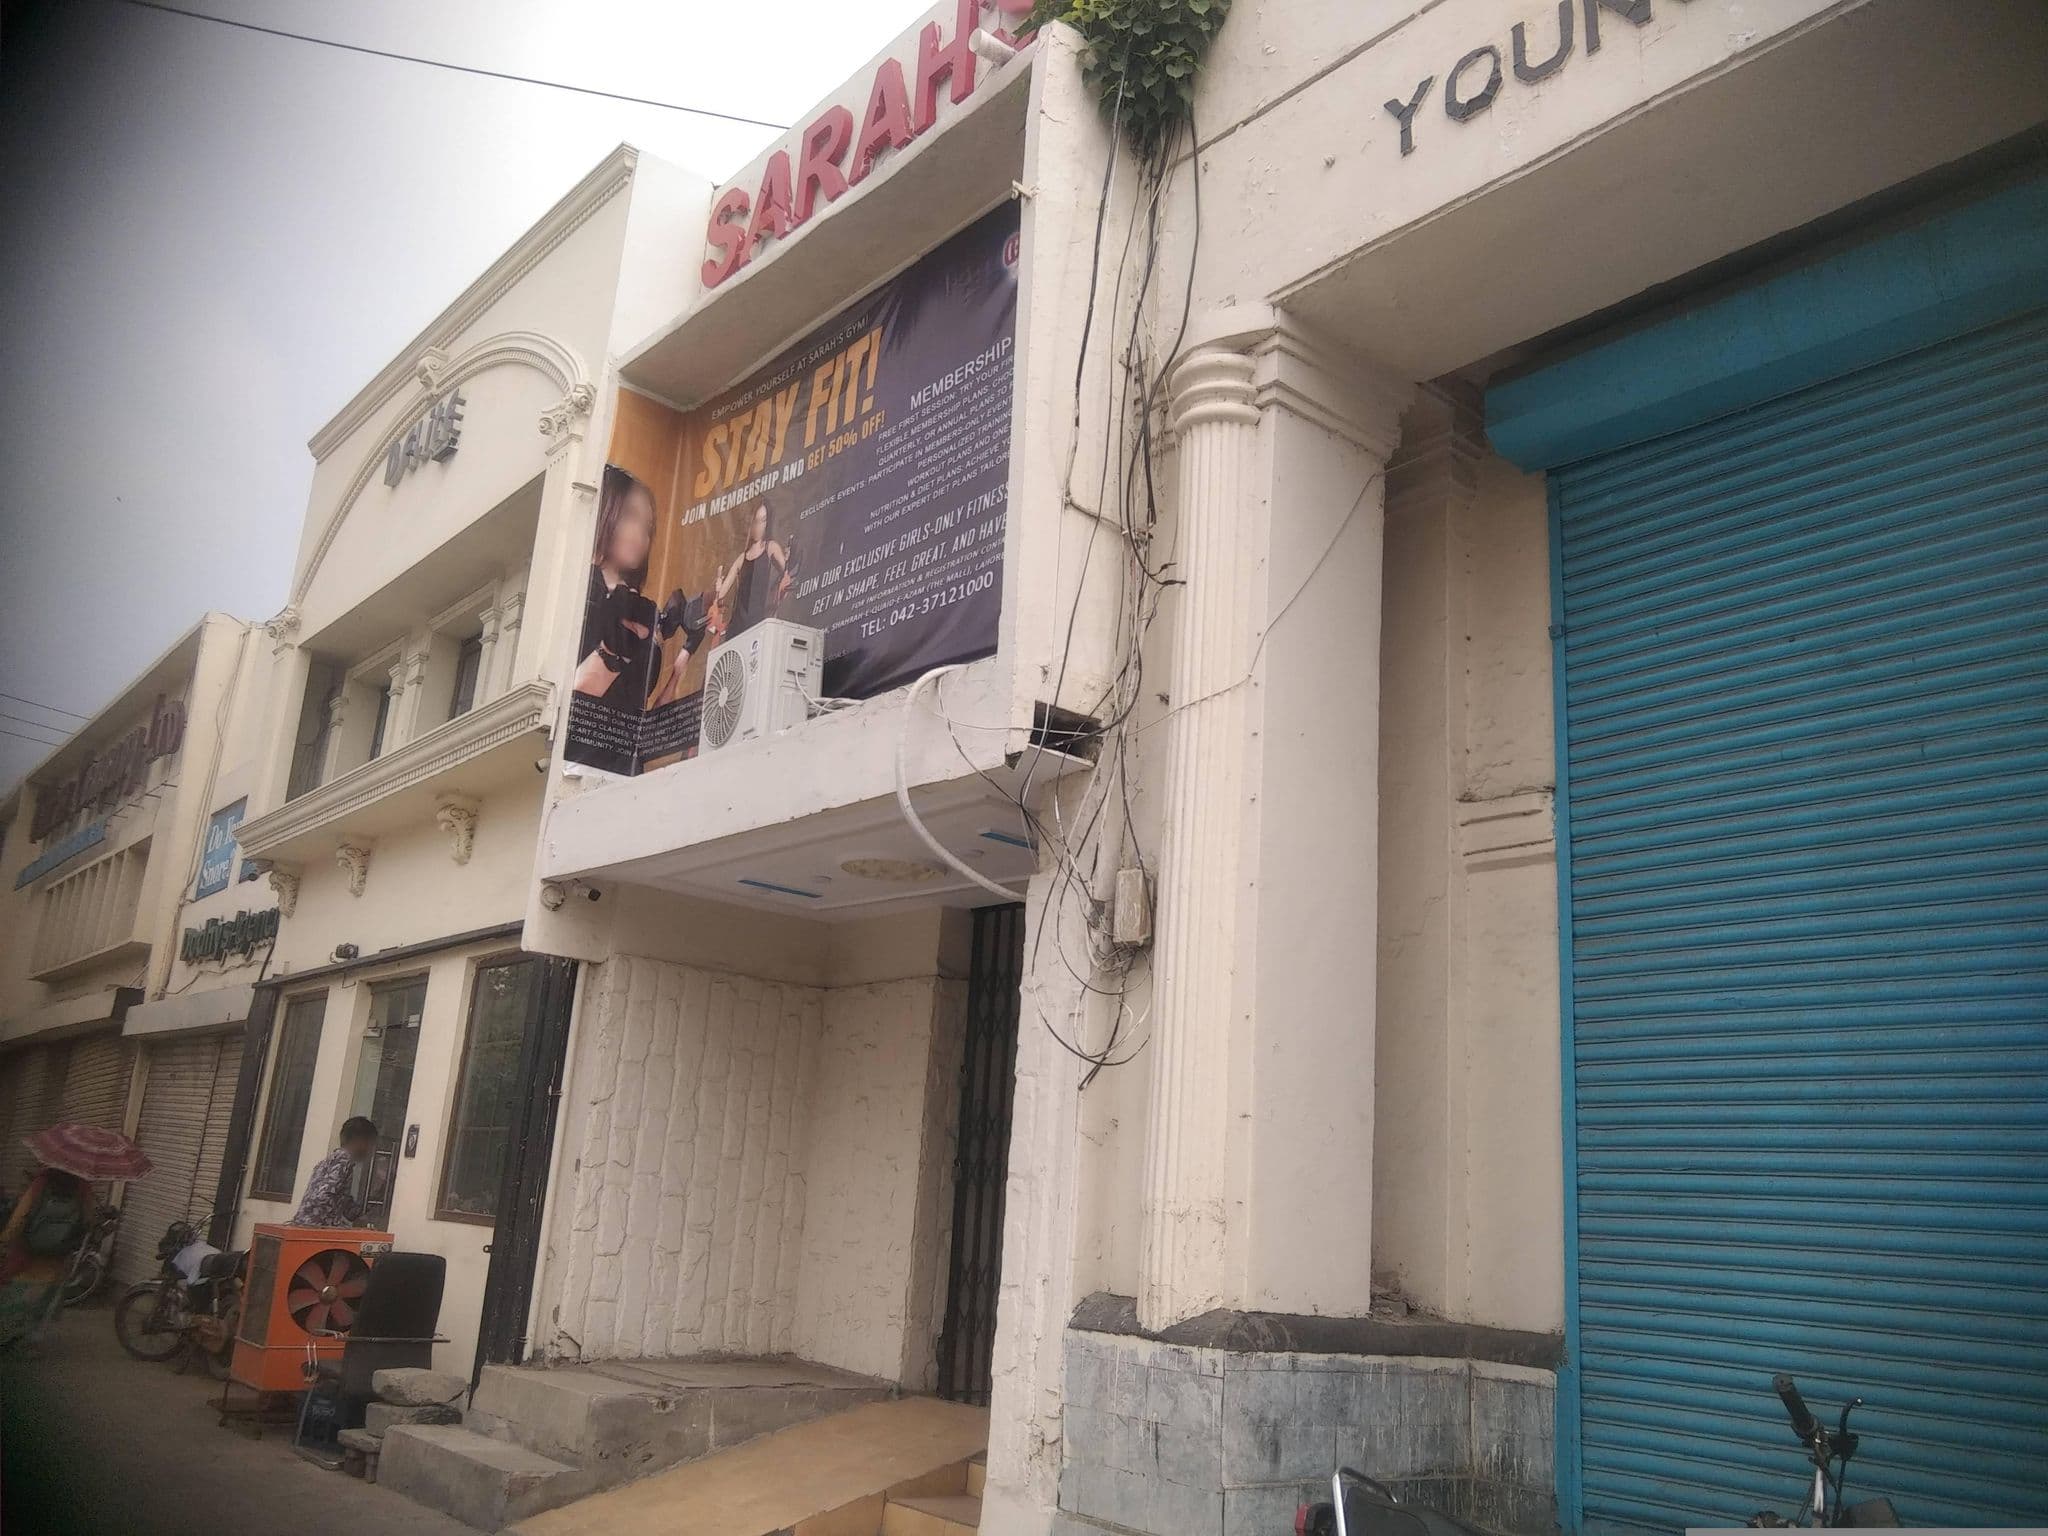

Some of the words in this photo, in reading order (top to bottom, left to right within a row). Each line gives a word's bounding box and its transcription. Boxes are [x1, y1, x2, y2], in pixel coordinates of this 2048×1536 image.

[1383, 0, 1690, 159] YOUN
[712, 391, 753, 420] EMPOWER
[756, 365, 795, 396] YOURSELF
[796, 359, 809, 374] AT
[809, 335, 844, 364] SARAH'S
[846, 314, 869, 339] GYM!
[878, 424, 896, 442] FREE
[898, 411, 919, 430] FIRST
[960, 379, 974, 394] TRY
[975, 364, 998, 384] YOUR
[910, 336, 1012, 411] MEMBERSHIP
[695, 381, 800, 499] STAY
[804, 326, 883, 449] FIT!
[876, 430, 909, 455] FLEXIBLE
[910, 400, 960, 436] MEMBERSHIP
[917, 430, 975, 470] PERSONALIZED
[924, 428, 936, 441] OR
[937, 410, 967, 433] ANNUAL
[969, 392, 994, 415] PLANS
[997, 384, 1007, 397] TO
[681, 503, 707, 527] JOIN
[709, 470, 780, 517] MEMBERSHIP
[782, 458, 805, 484] AND
[807, 446, 826, 471] GET
[828, 431, 858, 458] 50%
[861, 409, 886, 440] OFF!
[800, 493, 835, 520] EXCLUSIVE
[868, 453, 912, 484] PARTICIPATE
[915, 447, 922, 458] IN
[924, 412, 985, 453] MEMBERS-ONLY
[870, 493, 908, 519] NUTRITION
[910, 489, 915, 498] &
[917, 478, 934, 494] DIET
[966, 442, 999, 469] ACHIEVE
[907, 460, 945, 487] WORKOUT
[947, 445, 971, 466] PLANS
[973, 435, 990, 451] AND
[864, 518, 882, 534] WITH
[883, 509, 900, 524] OUR
[901, 492, 931, 515] EXPERT
[932, 483, 950, 499] DIET
[952, 468, 977, 488] PLANS
[796, 574, 819, 599] JOIN
[821, 564, 841, 588] OUR
[843, 538, 896, 577] EXCLUSIVE
[899, 504, 964, 551] GIRLS-ONLY
[812, 593, 831, 615] GET
[832, 588, 844, 606] IN
[883, 559, 906, 584] FEEL
[952, 527, 975, 553] AND
[978, 511, 1007, 541] HAVE
[852, 599, 864, 610] FOR
[866, 576, 915, 604] INFORMATION
[925, 549, 977, 579] REGISTRATION
[861, 617, 886, 639] TEL:
[890, 571, 994, 626] 042-37121000
